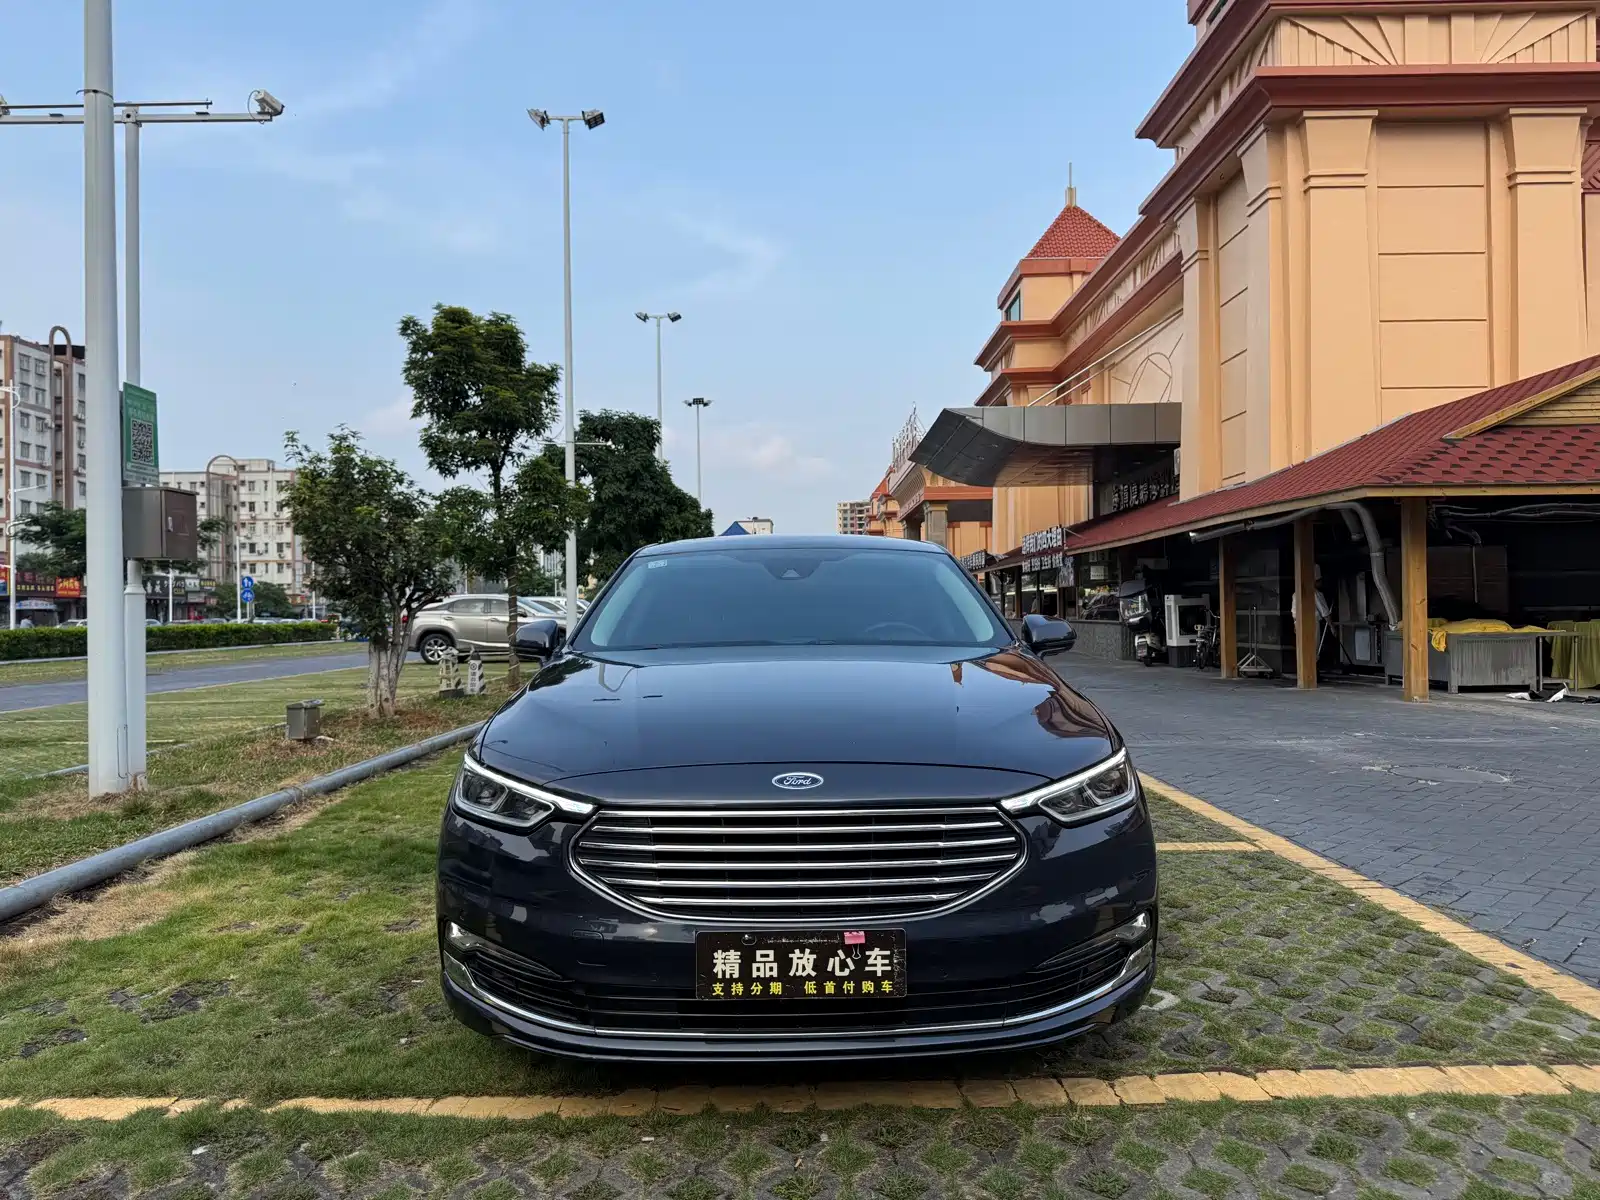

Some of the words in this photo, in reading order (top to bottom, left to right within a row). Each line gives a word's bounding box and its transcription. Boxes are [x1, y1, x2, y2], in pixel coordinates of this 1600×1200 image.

[783, 775, 812, 785] Ford
[713, 948, 892, 979] 精品放心车
[712, 982, 783, 996] 支持分期
[804, 980, 894, 995] 低首付购车
